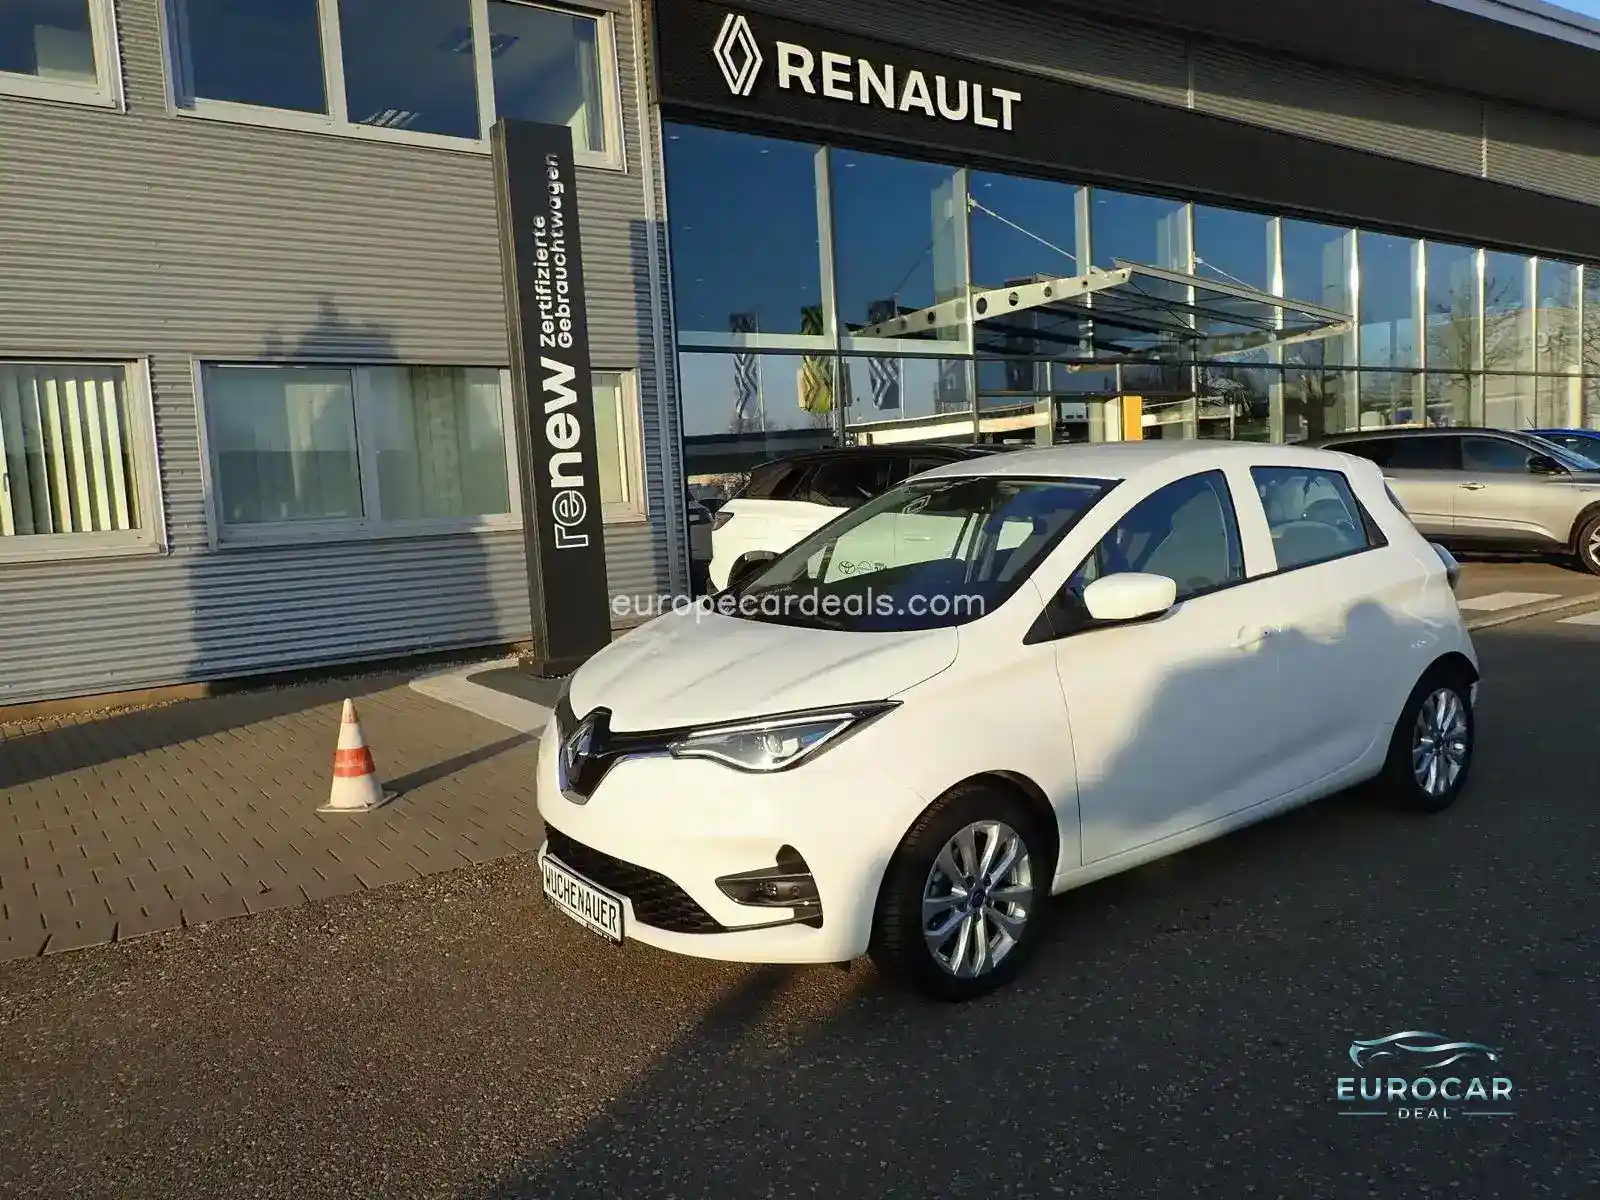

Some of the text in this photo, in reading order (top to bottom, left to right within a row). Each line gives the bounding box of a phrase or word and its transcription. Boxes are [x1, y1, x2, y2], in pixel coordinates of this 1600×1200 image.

[776, 41, 1021, 131] RENAULT
[533, 215, 556, 348] Zertifizierte
[546, 153, 573, 349] Gebrauchtwagen
[540, 356, 589, 549] renew
[543, 864, 617, 934] WUCHENAUER
